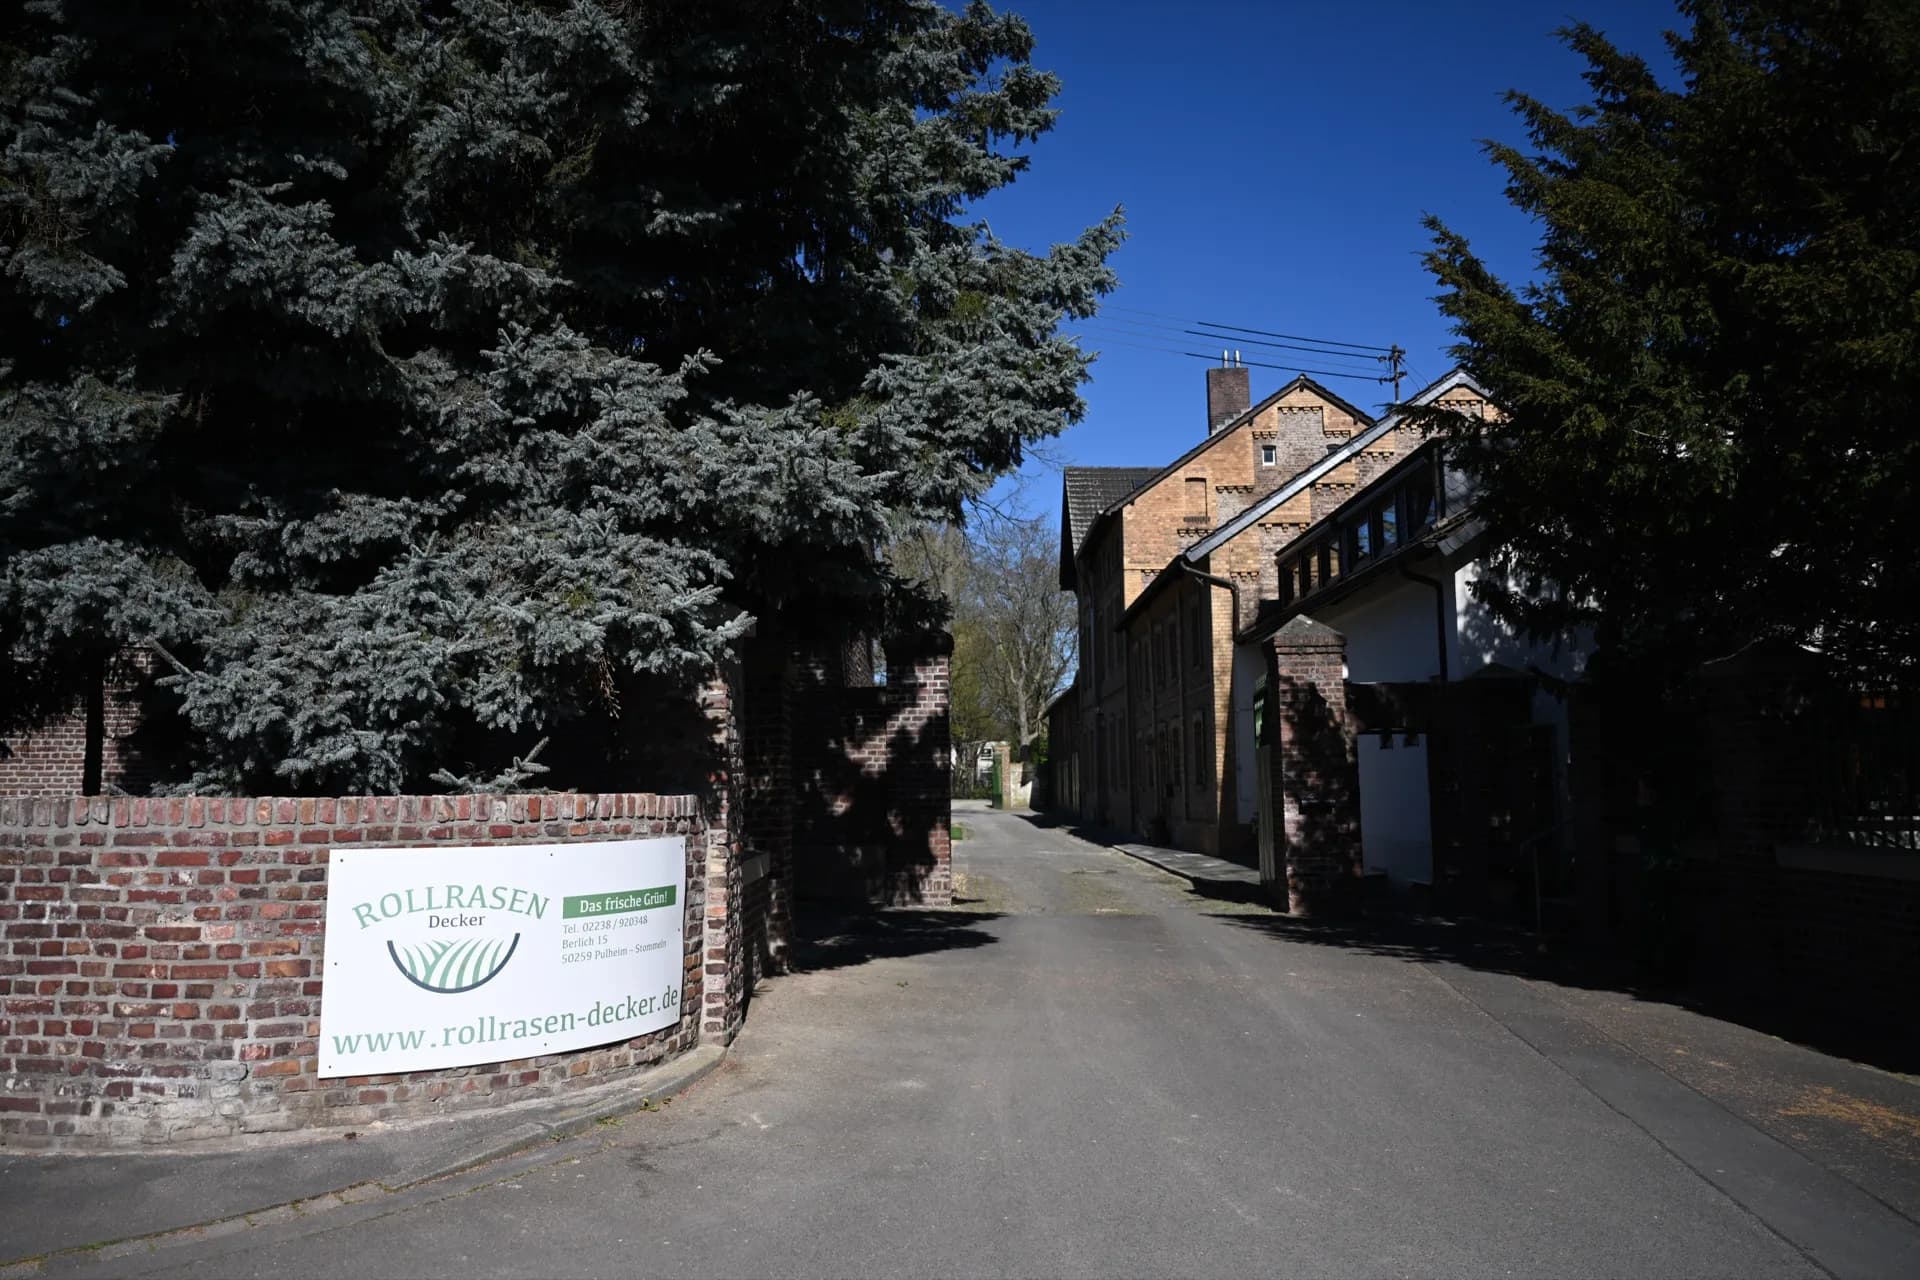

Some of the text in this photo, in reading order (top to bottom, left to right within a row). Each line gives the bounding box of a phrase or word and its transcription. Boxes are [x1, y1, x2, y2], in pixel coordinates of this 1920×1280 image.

[352, 884, 550, 930] ROLLRASEN
[580, 890, 668, 913] Das frische Grün!
[428, 913, 486, 929] Decker
[563, 923, 579, 934] Tel.
[561, 951, 592, 964] 50259
[595, 946, 628, 960] Pulheim
[635, 939, 667, 953] Stommeln
[562, 934, 608, 949] Berlich 15
[333, 985, 679, 1056] www.rollrasen-decker.de
